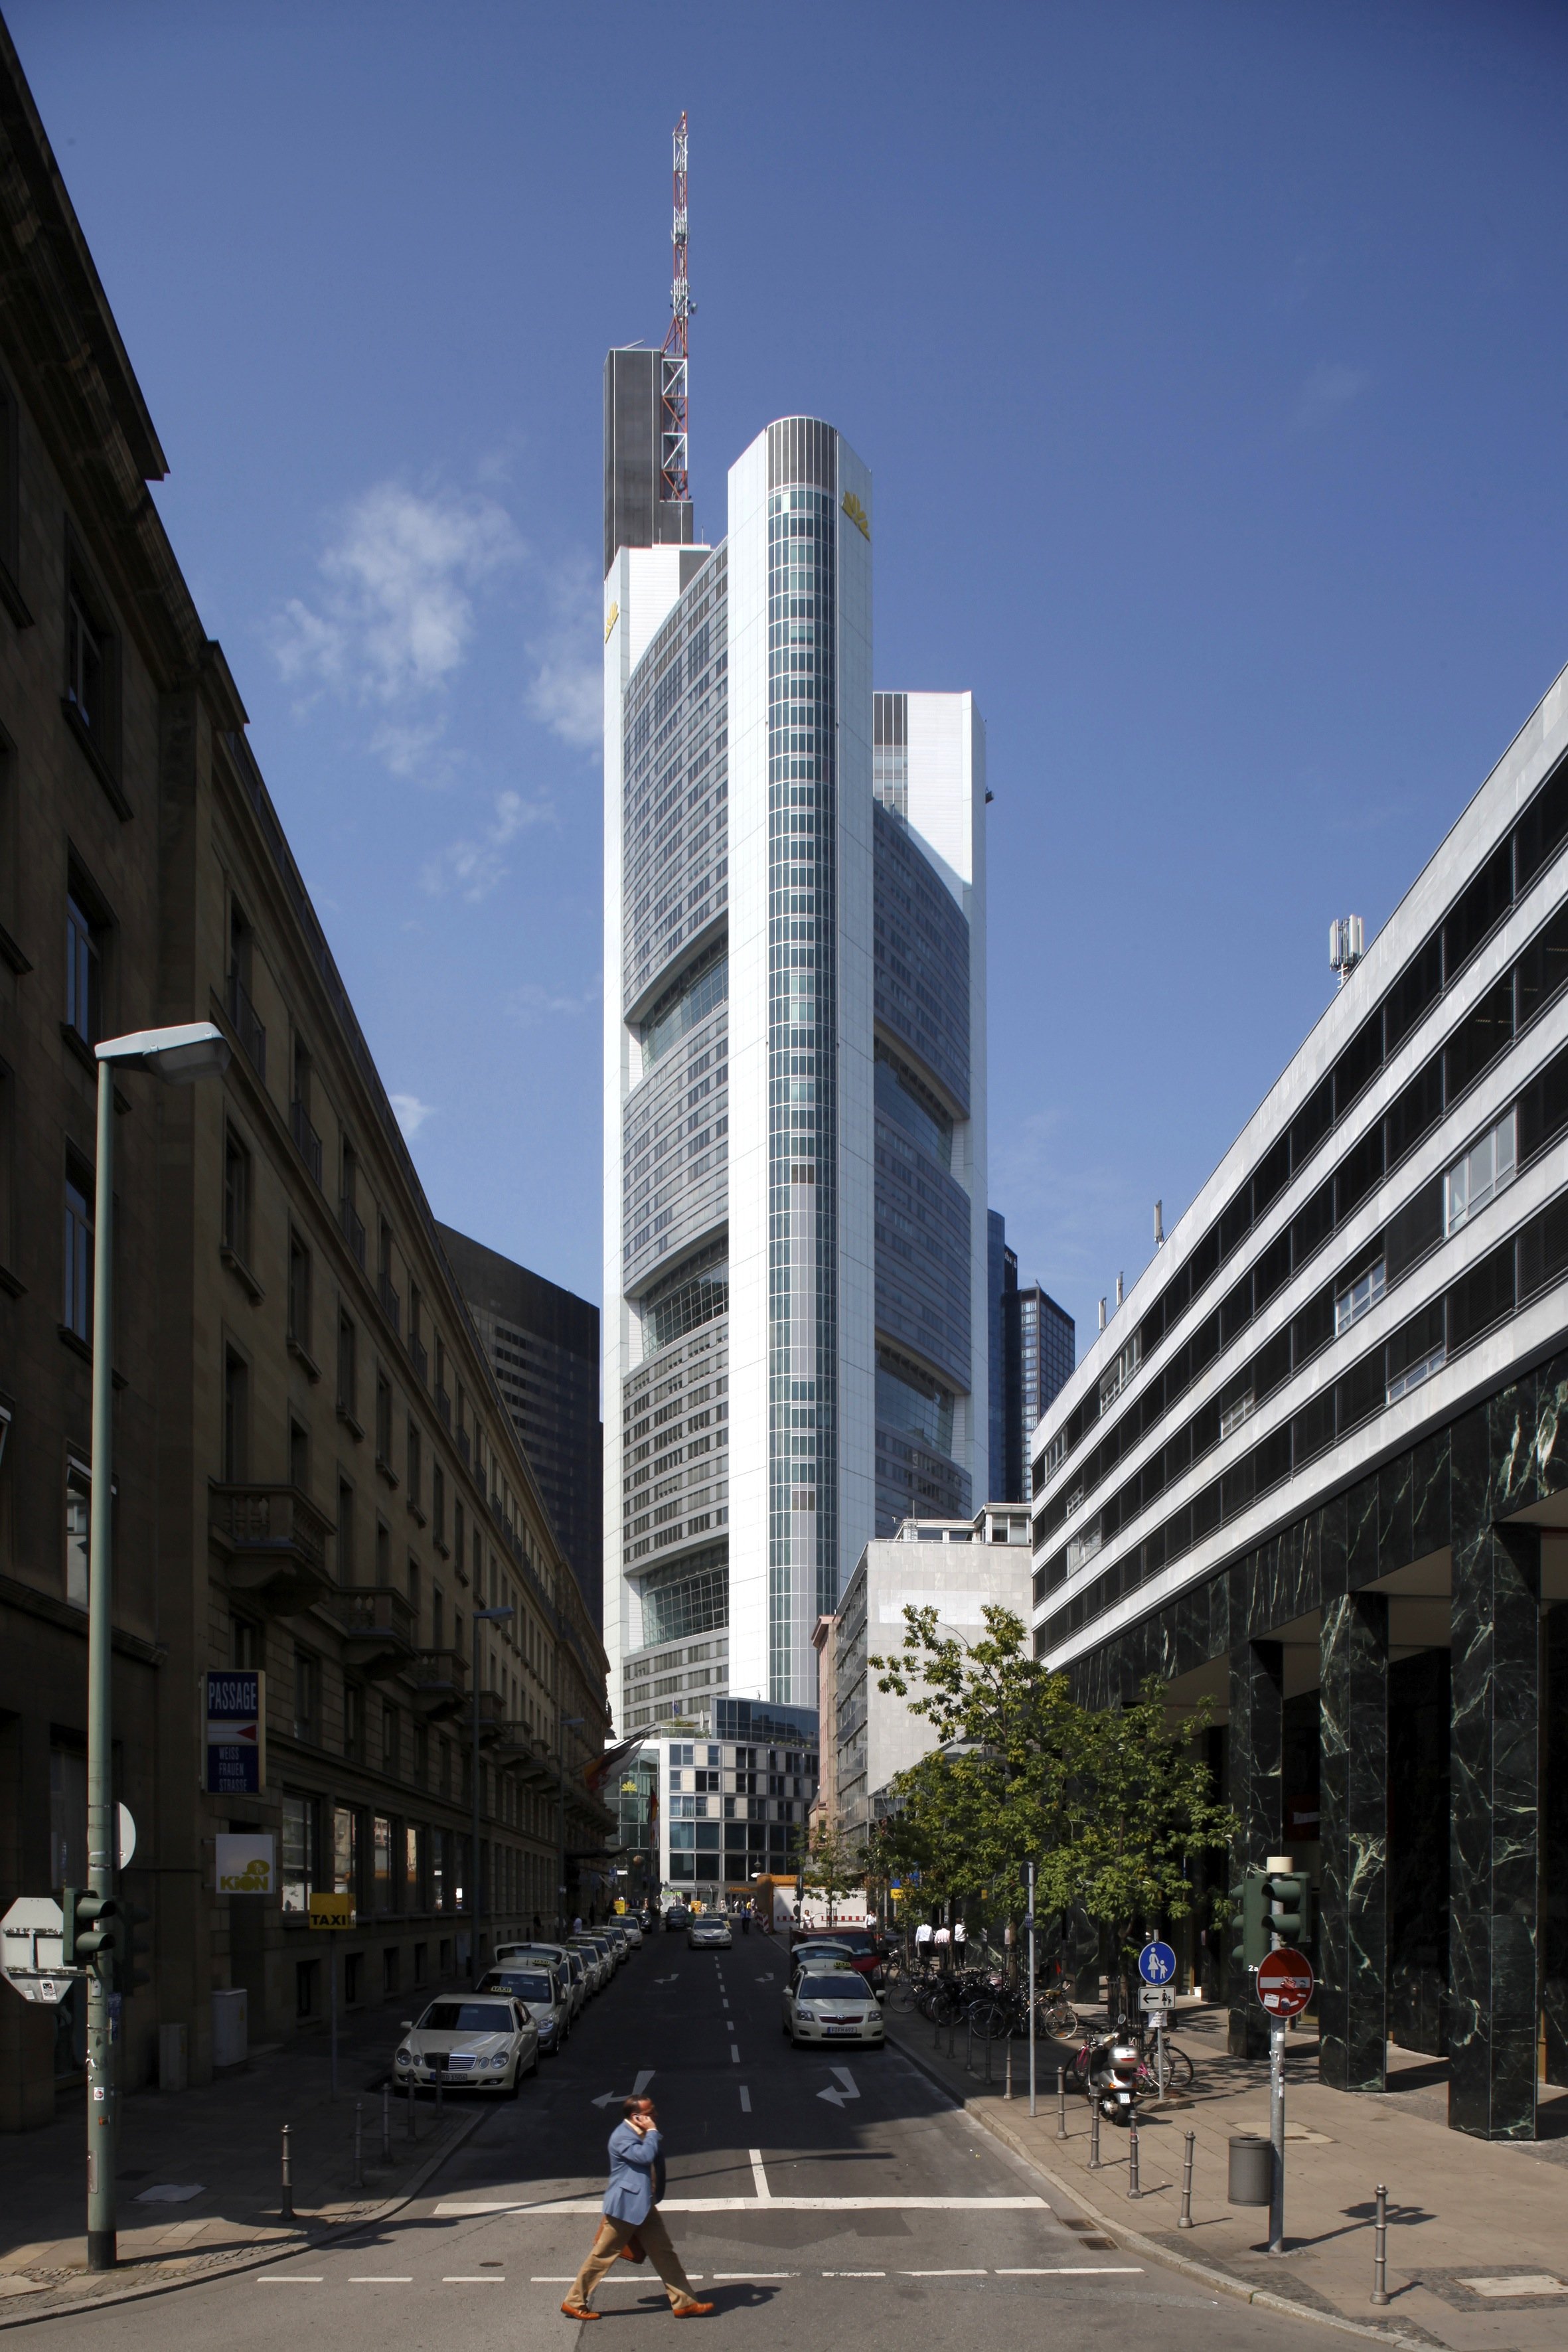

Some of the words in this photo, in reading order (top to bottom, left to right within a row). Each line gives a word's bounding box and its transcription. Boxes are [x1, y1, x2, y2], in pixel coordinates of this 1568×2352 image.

[208, 1682, 256, 1710] PASSAGE
[219, 1747, 239, 1760] WEISS
[219, 1763, 244, 1776] FRAUEN
[219, 1778, 247, 1792] STRASSE
[311, 1915, 346, 1925] TAXI
